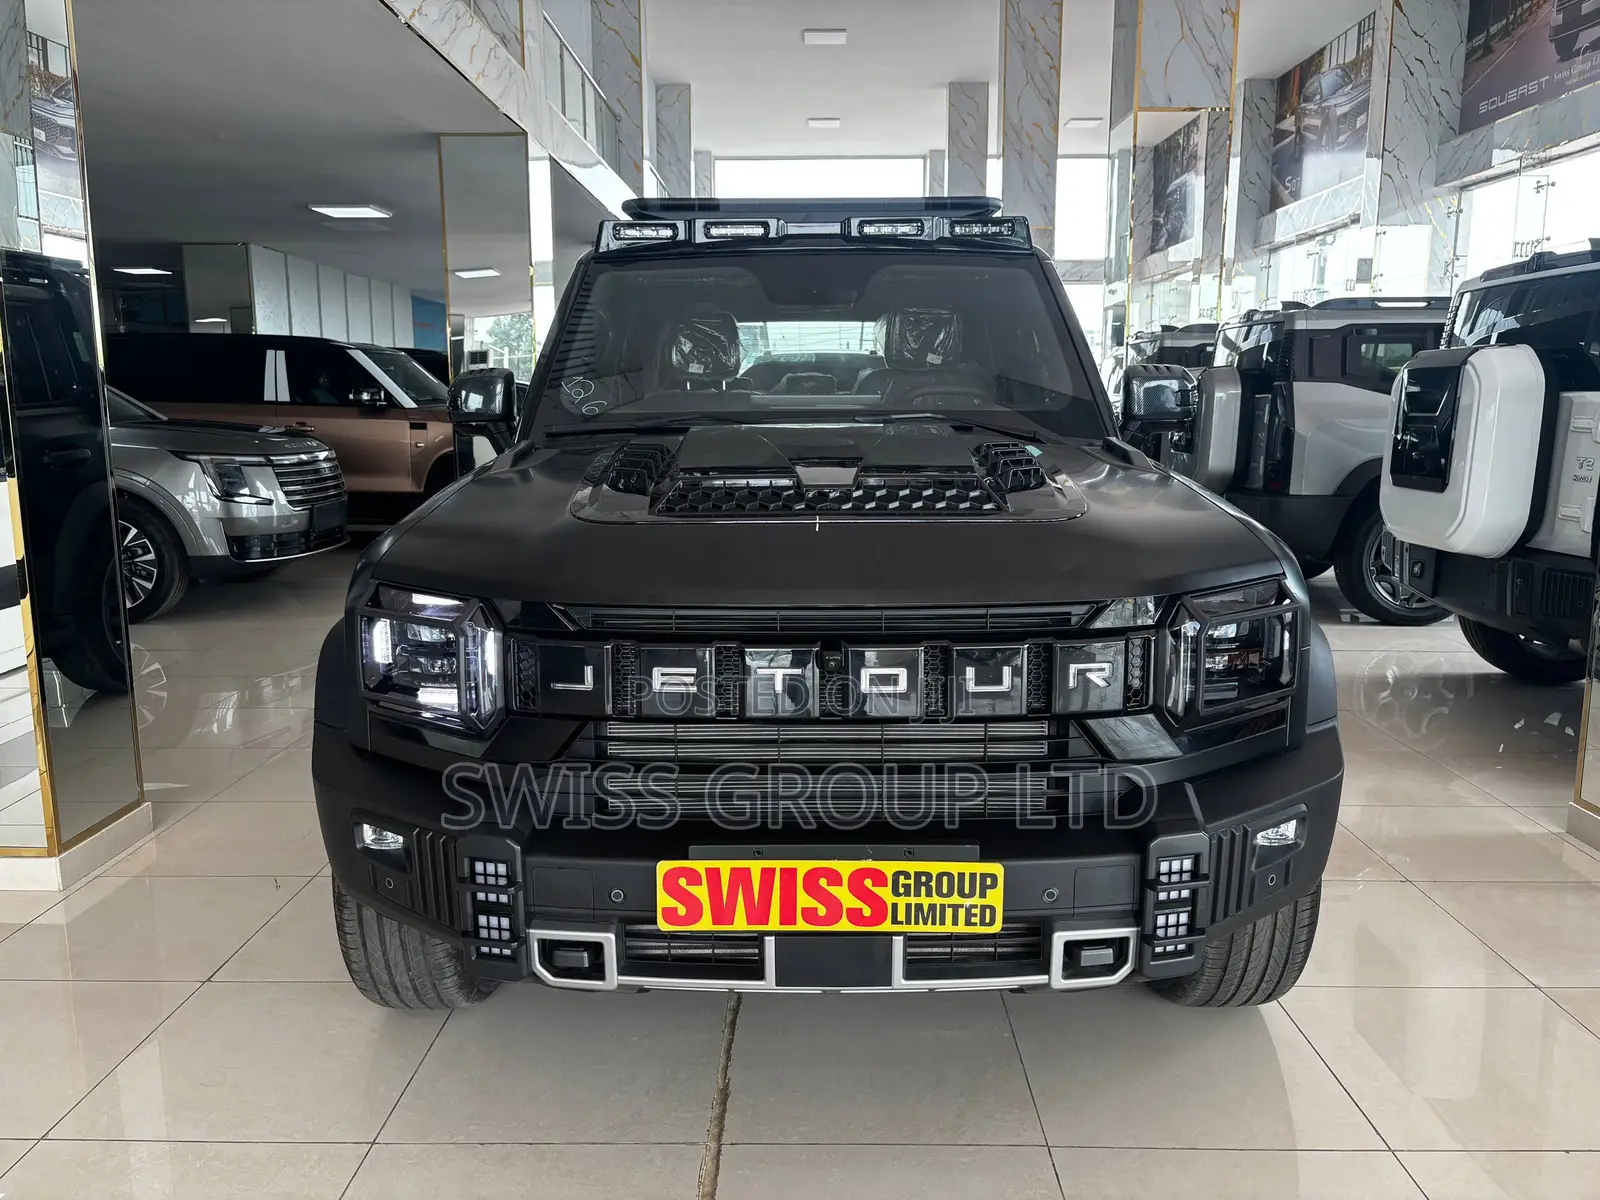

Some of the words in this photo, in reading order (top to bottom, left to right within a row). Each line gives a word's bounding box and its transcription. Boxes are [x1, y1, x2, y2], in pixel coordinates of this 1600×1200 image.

[1479, 76, 1549, 114] SOUEAST
[551, 661, 1113, 693] JETOUR
[661, 866, 888, 928] SWISS
[891, 871, 999, 900] GROUP
[891, 902, 997, 928] LIMITED
